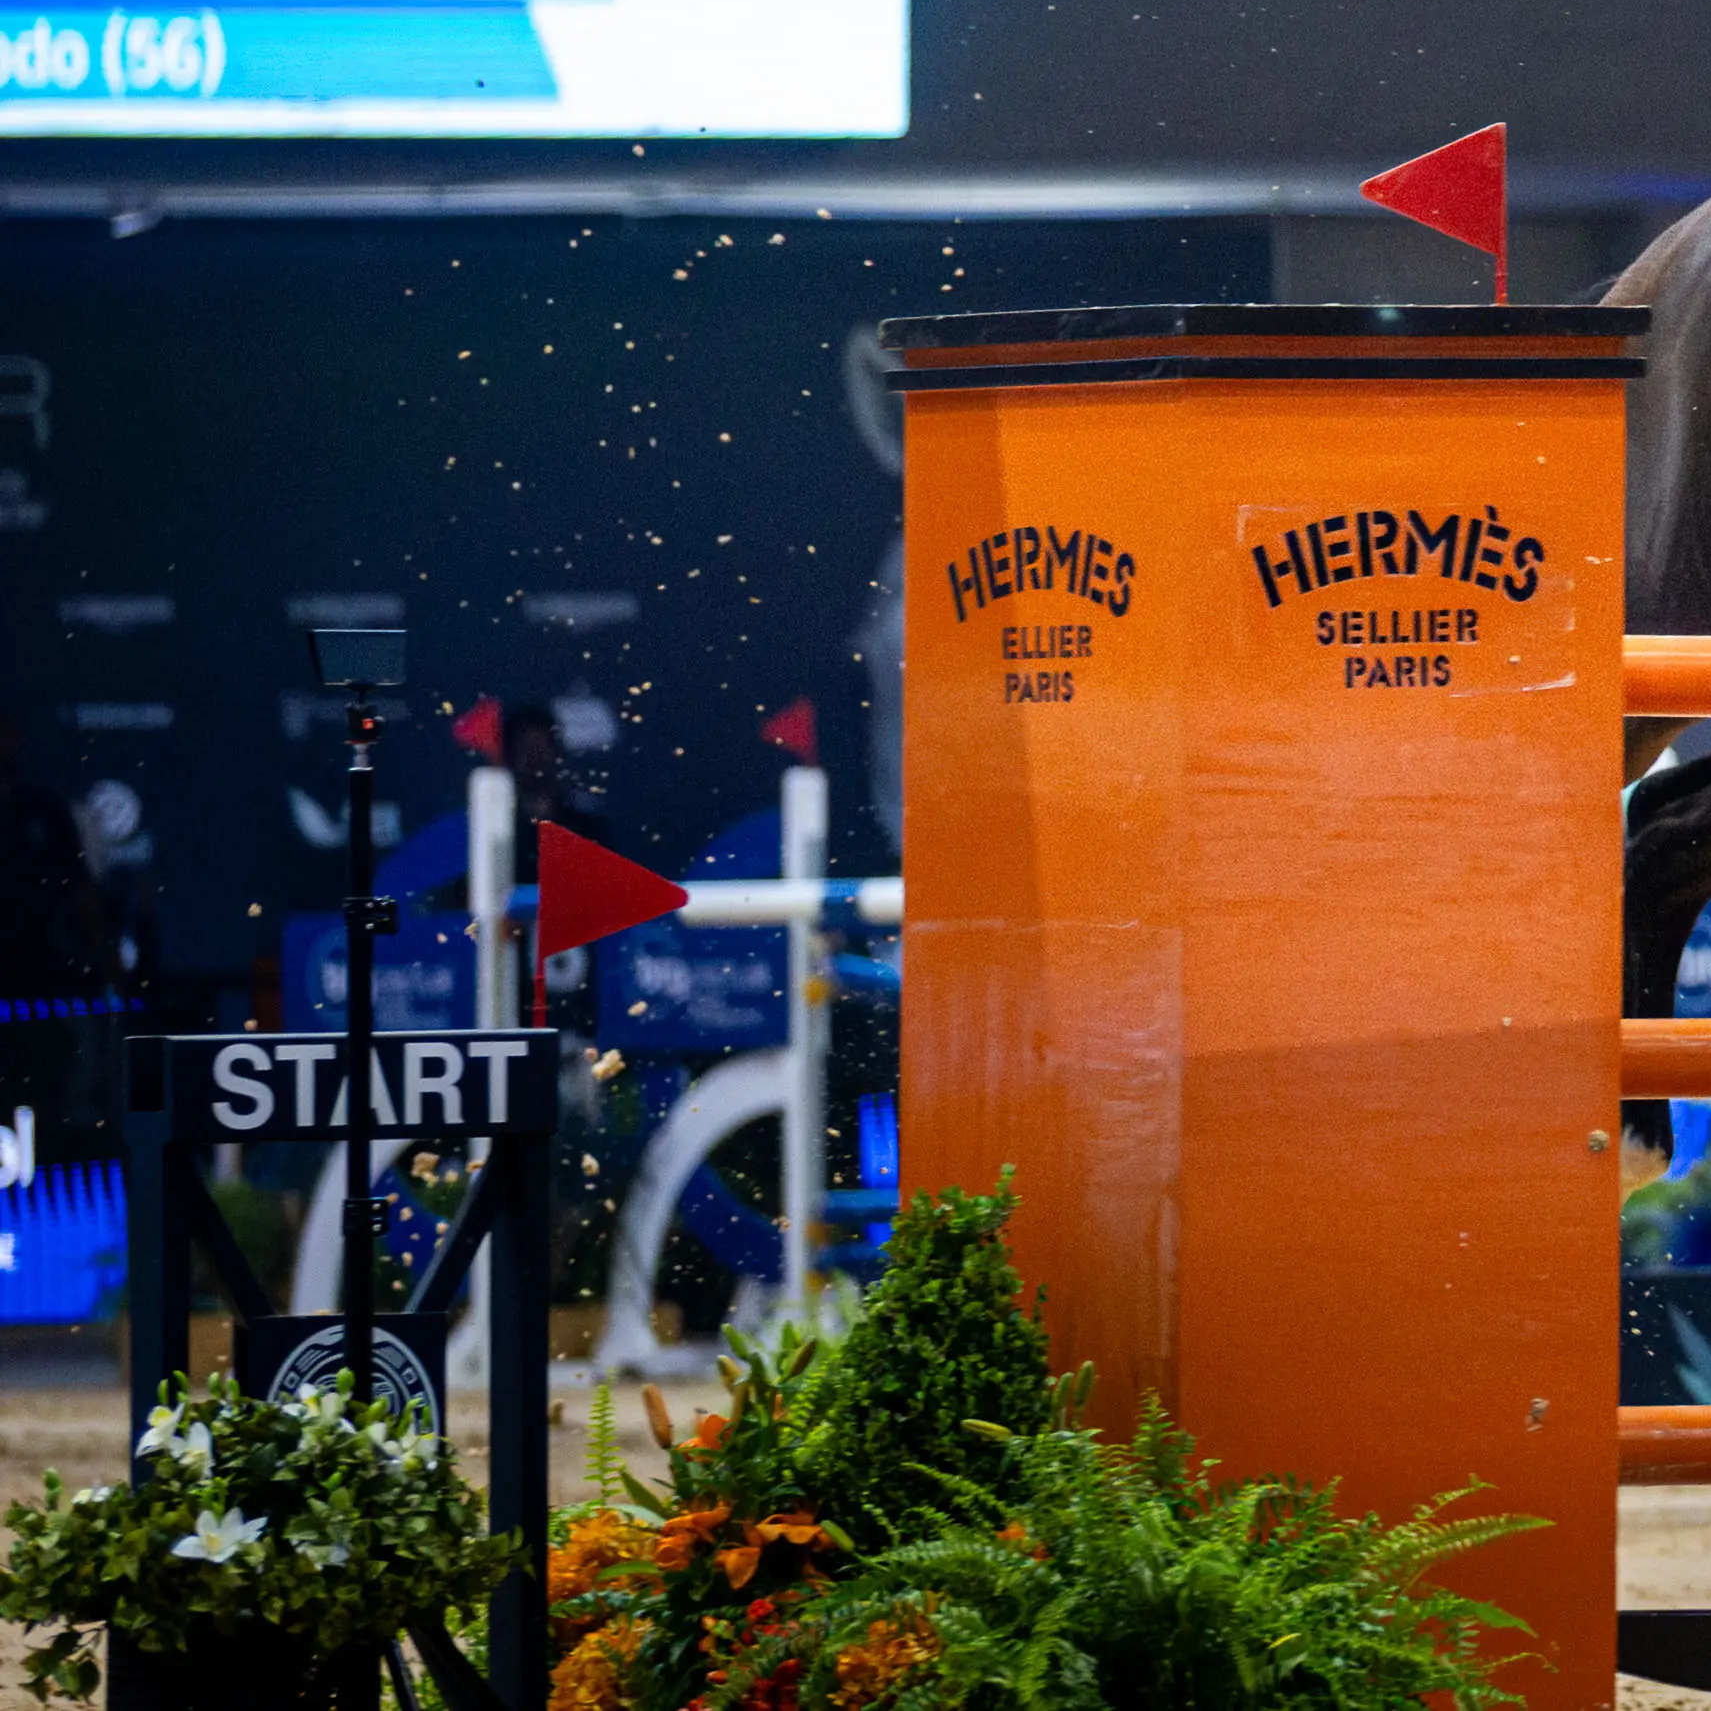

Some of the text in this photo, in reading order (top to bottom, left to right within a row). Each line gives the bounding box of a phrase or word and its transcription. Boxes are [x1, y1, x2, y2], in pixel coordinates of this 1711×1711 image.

[101, 6, 227, 100] (56)
[1251, 504, 1545, 609] HERMÈS
[1316, 608, 1480, 646] SELLIER
[1004, 670, 1075, 704] PARIS
[1344, 654, 1452, 689] PARIS
[211, 1040, 530, 1131] START
